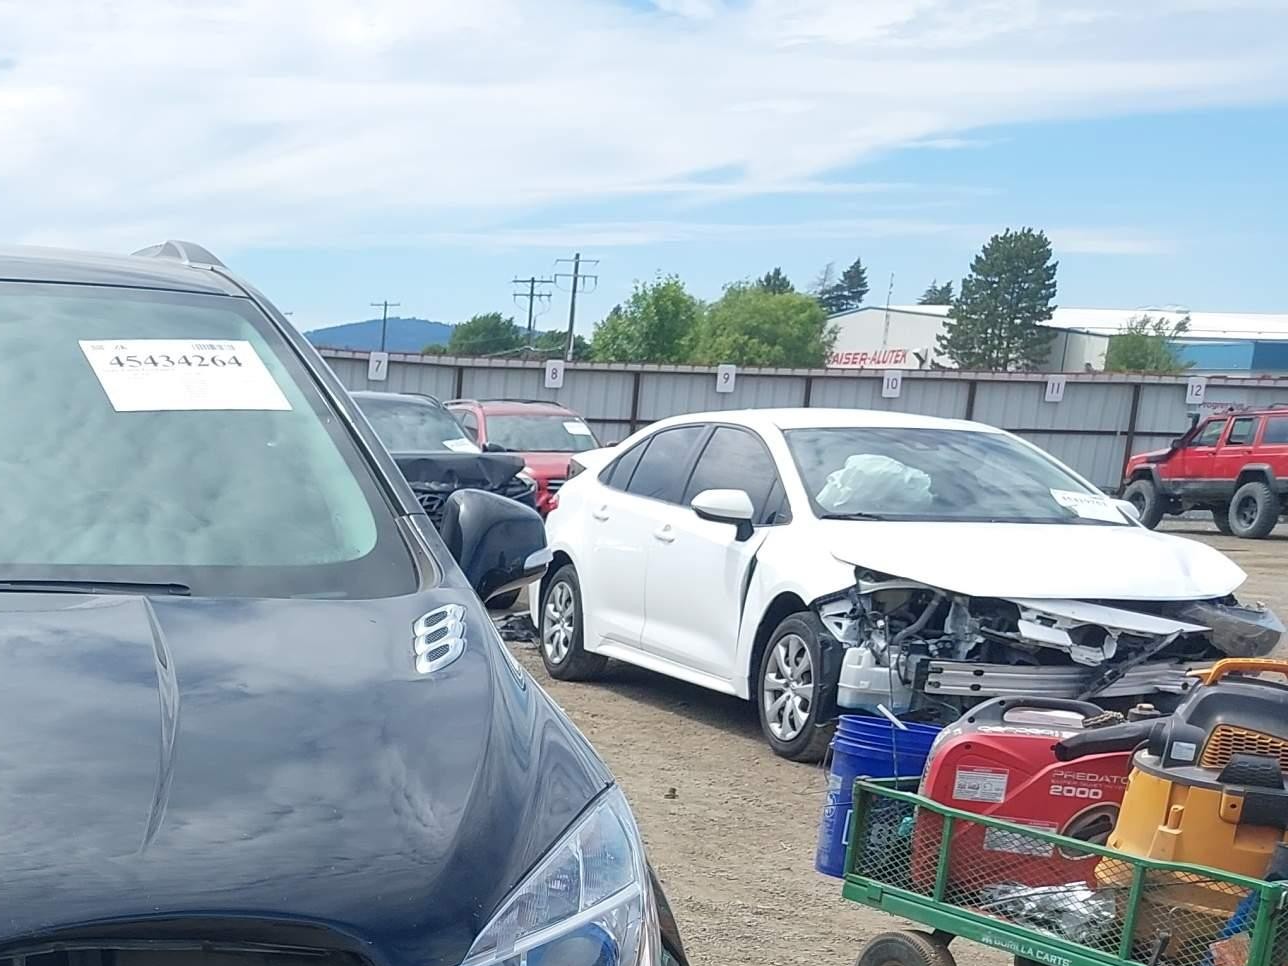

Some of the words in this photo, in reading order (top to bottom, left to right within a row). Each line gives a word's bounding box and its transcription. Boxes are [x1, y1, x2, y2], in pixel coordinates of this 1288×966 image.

[109, 354, 243, 368] 45434264
[375, 359, 383, 373] 7
[550, 367, 558, 380] 8
[722, 372, 730, 384] 9
[886, 378, 898, 390] 10
[1049, 383, 1061, 394] 11
[1191, 385, 1202, 396] 12
[1049, 785, 1103, 800] 2000
